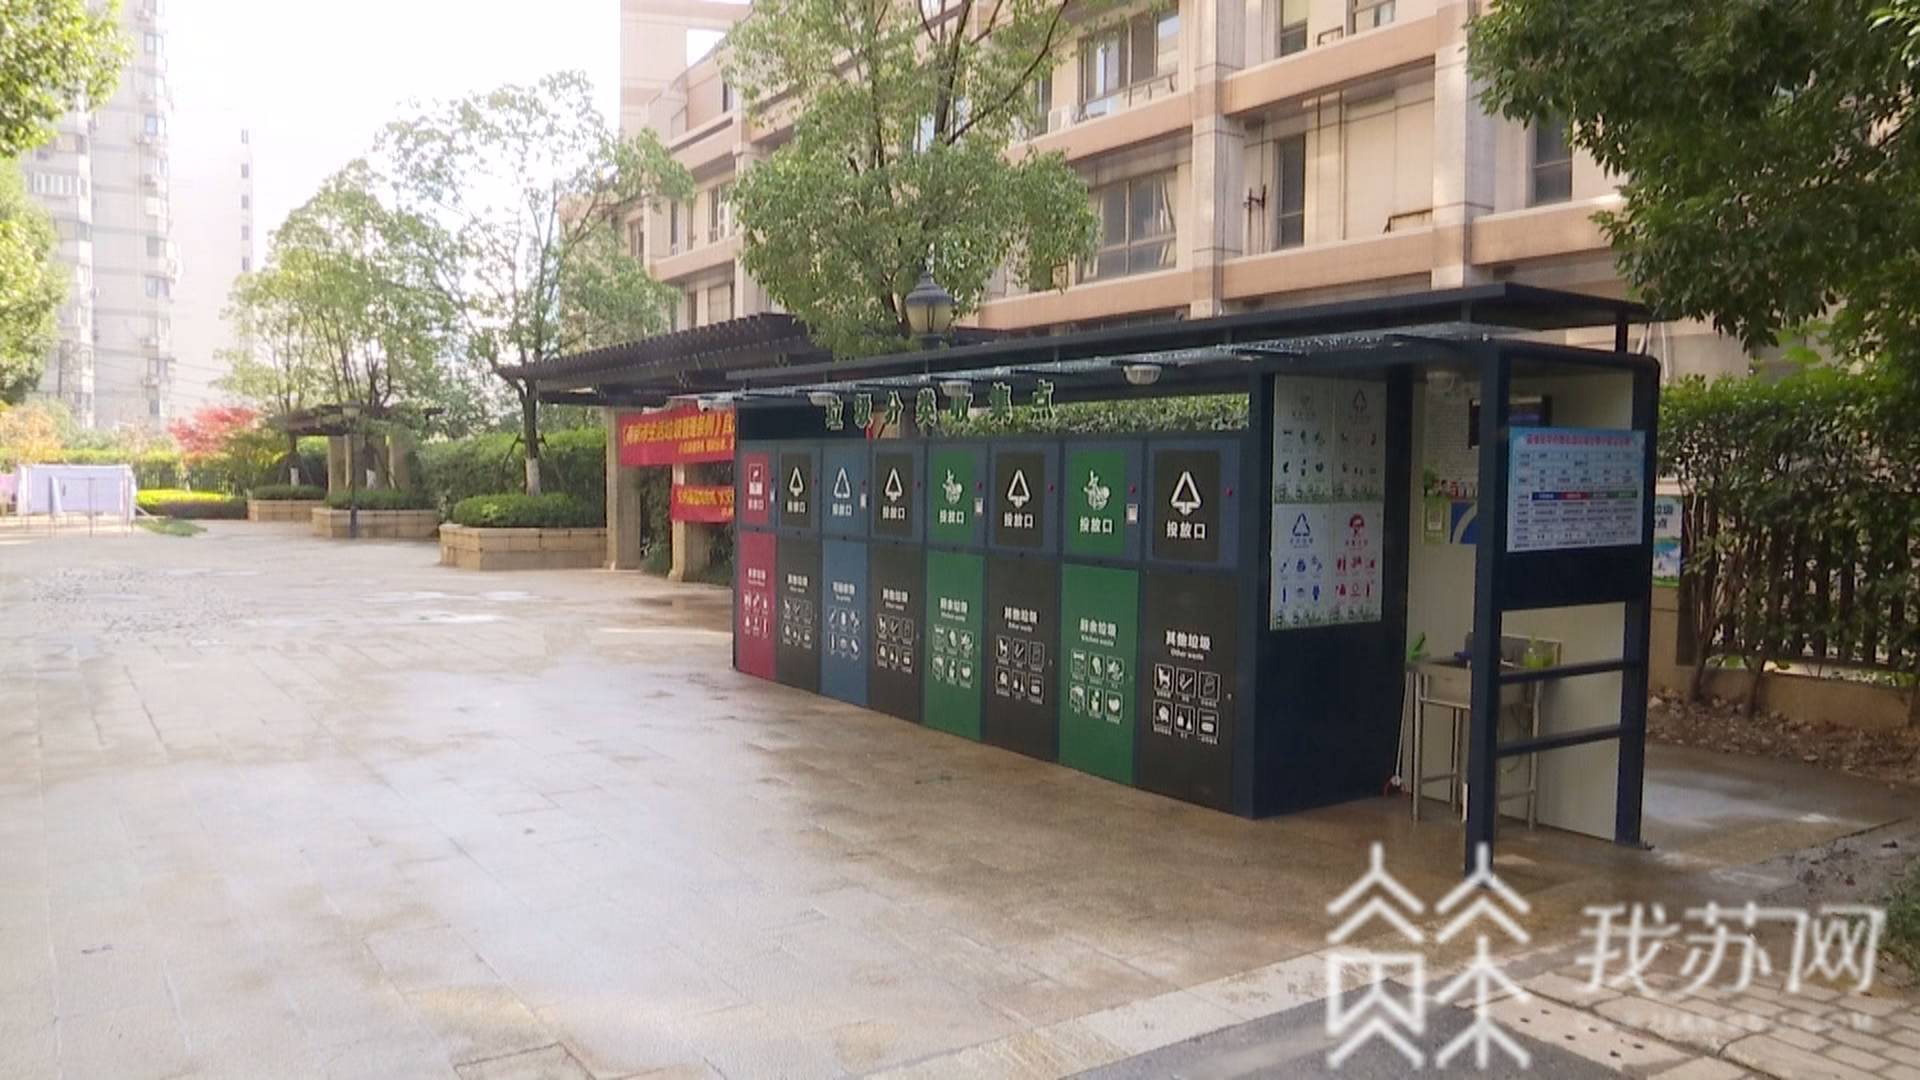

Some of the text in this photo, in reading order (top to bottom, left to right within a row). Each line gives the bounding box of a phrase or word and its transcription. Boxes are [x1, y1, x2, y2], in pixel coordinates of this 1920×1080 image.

[939, 509, 965, 524] 投放口
[1003, 513, 1034, 528] 投放口
[1080, 516, 1113, 534] 投放口
[1166, 520, 1206, 539] 投放口
[1004, 606, 1037, 624] 其他垃圾
[1080, 618, 1116, 637] 厨余垃圾
[1166, 630, 1210, 650] 其他垃圾
